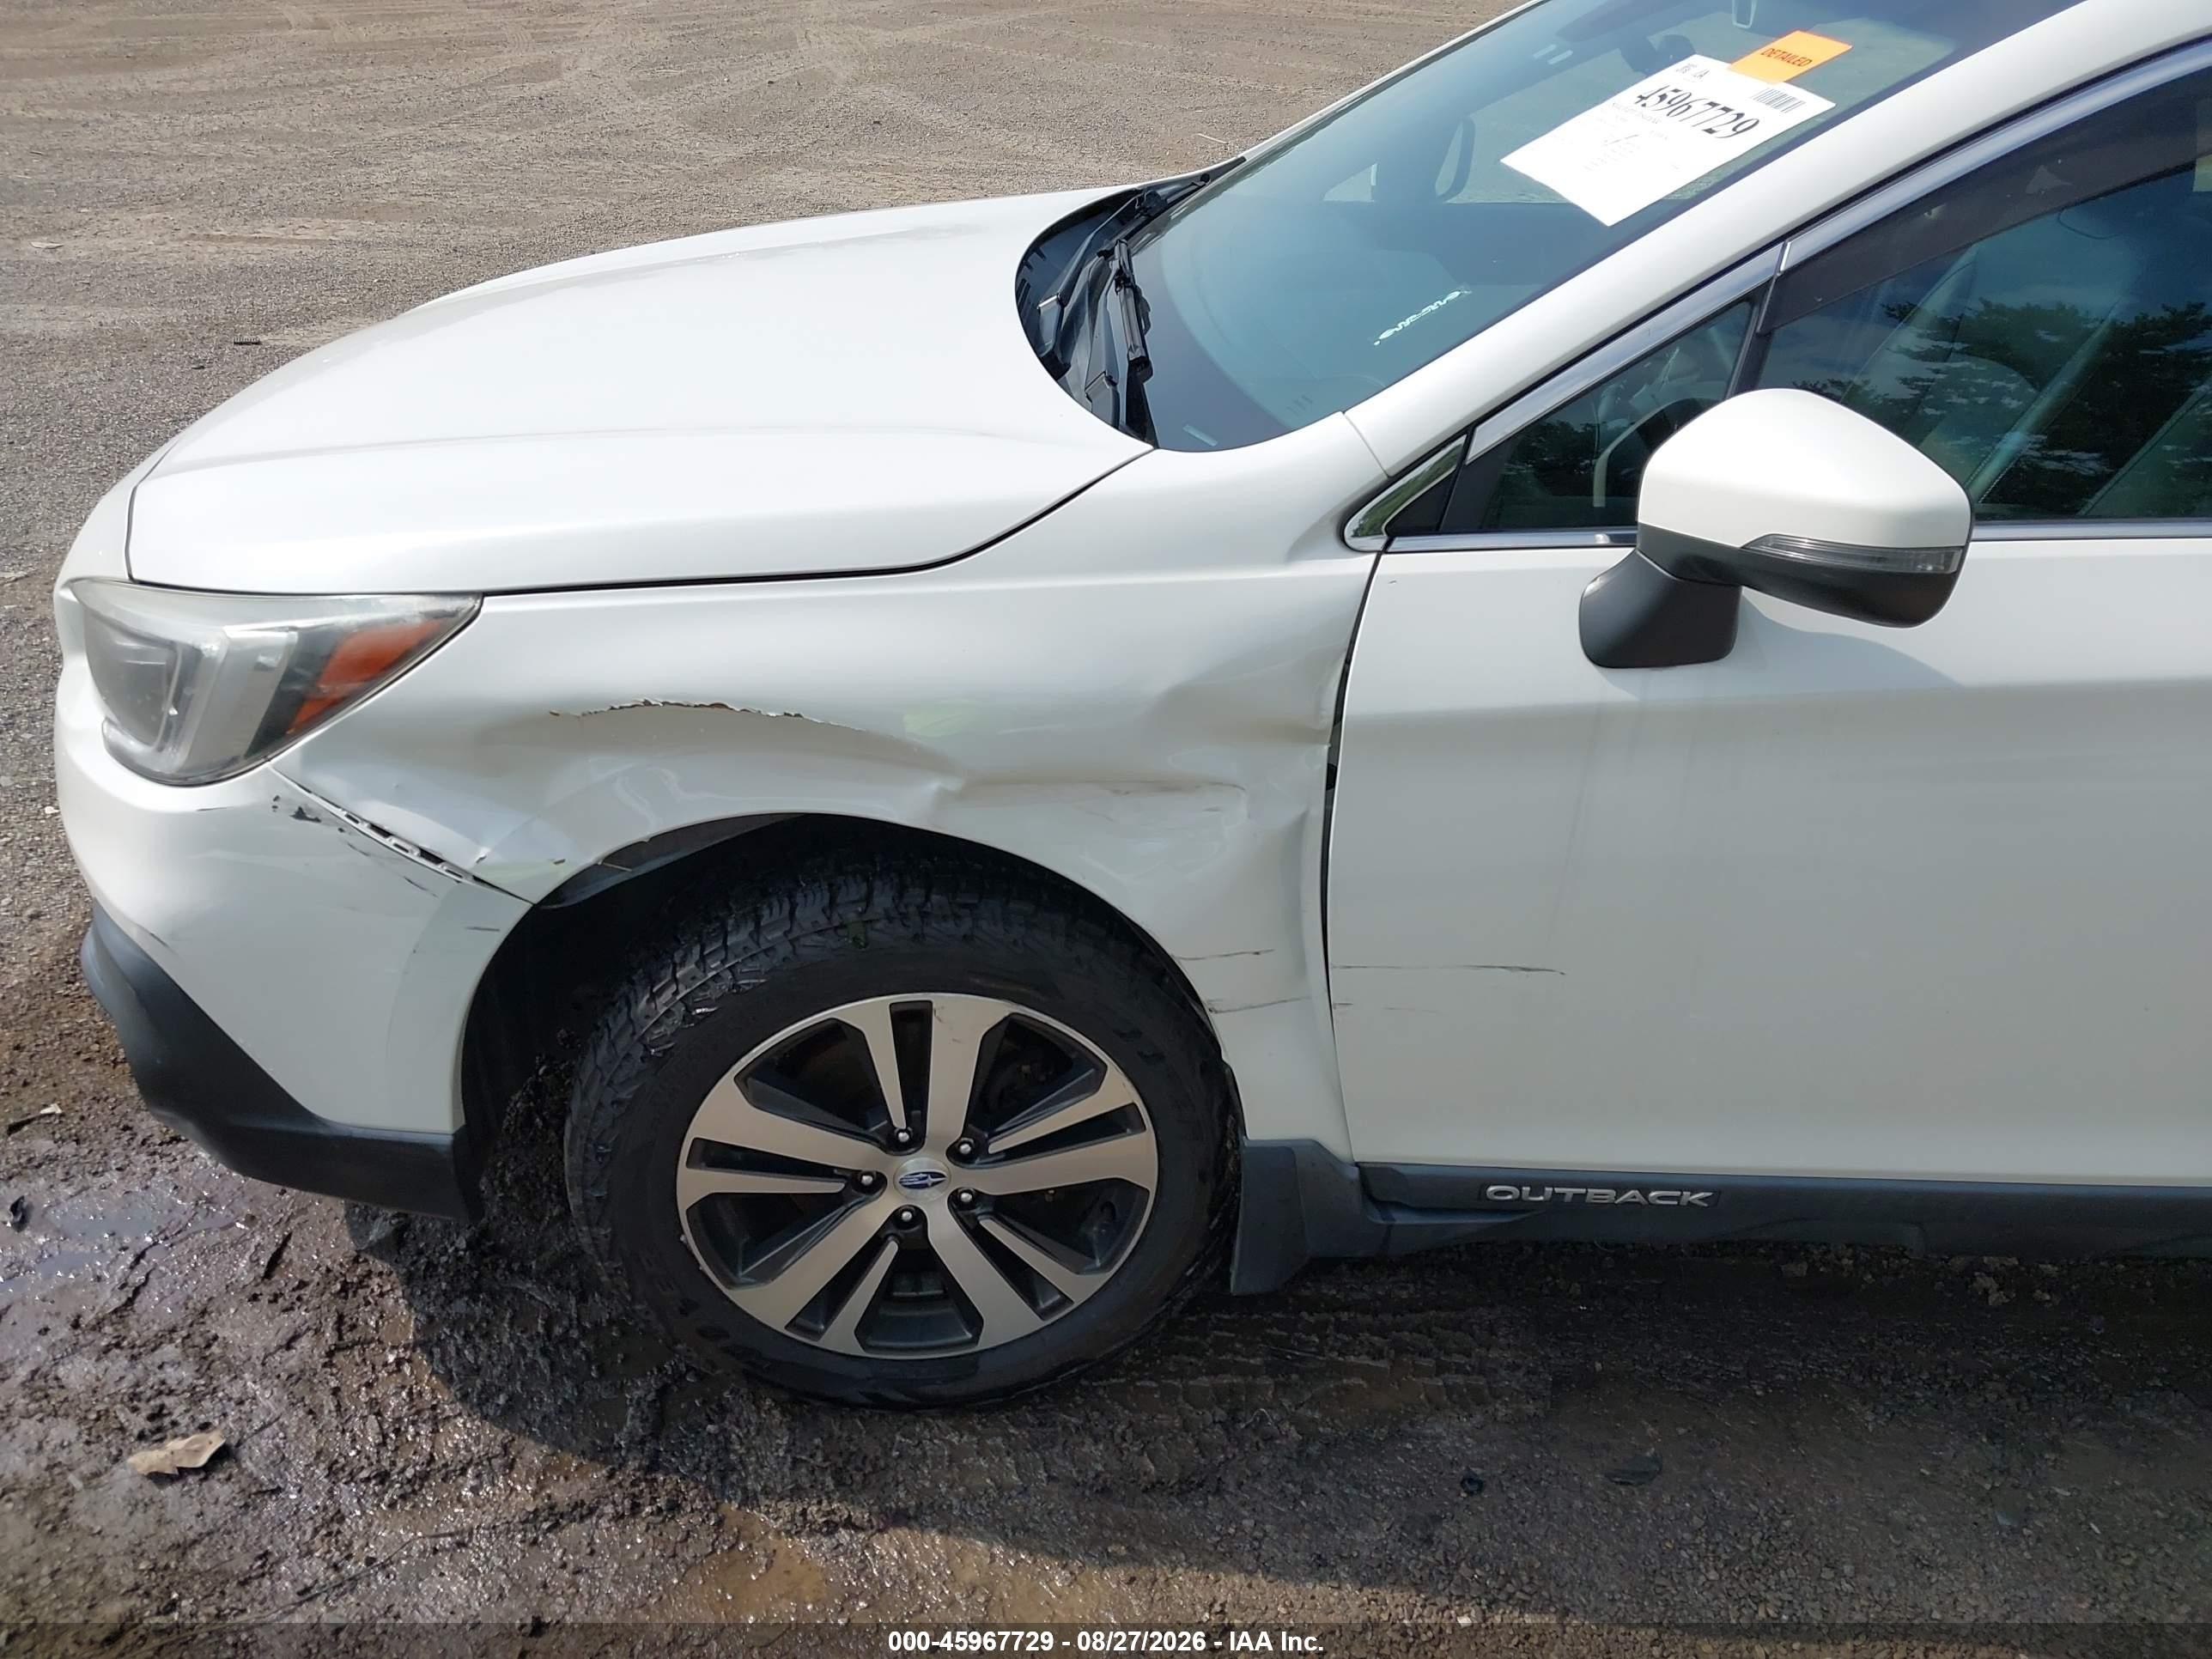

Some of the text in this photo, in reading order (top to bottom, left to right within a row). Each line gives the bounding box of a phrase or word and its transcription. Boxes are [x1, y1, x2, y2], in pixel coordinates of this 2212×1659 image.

[1760, 48, 1813, 67] DETAILED
[1633, 84, 1760, 139] 45967729
[1486, 1185, 1714, 1207] OUTBACK
